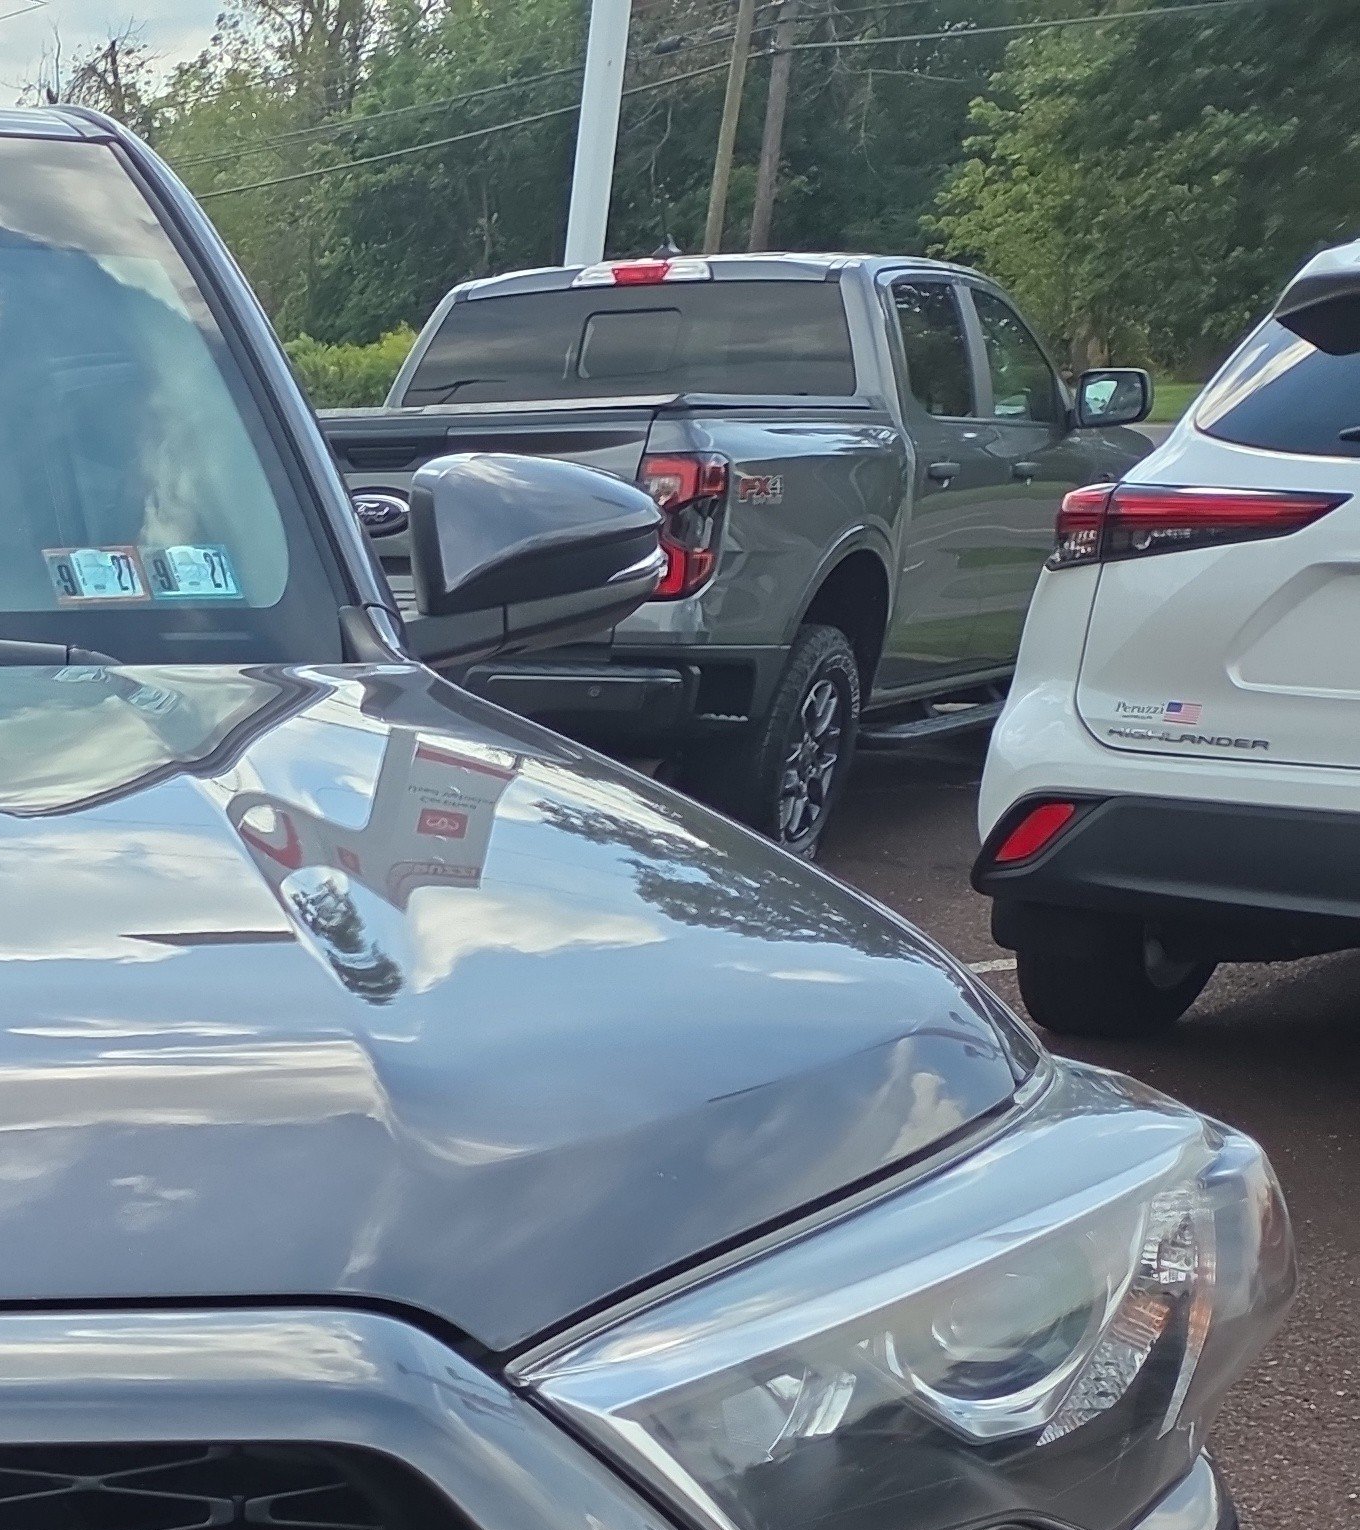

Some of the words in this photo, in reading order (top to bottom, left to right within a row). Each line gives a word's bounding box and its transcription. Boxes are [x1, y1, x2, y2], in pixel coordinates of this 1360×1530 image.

[739, 475, 783, 502] FX4
[56, 564, 78, 596] 9
[110, 554, 136, 595] 27
[202, 551, 229, 591] 27
[1115, 701, 1165, 715] Peruzzi
[1107, 726, 1271, 751] HIGHLANDER
